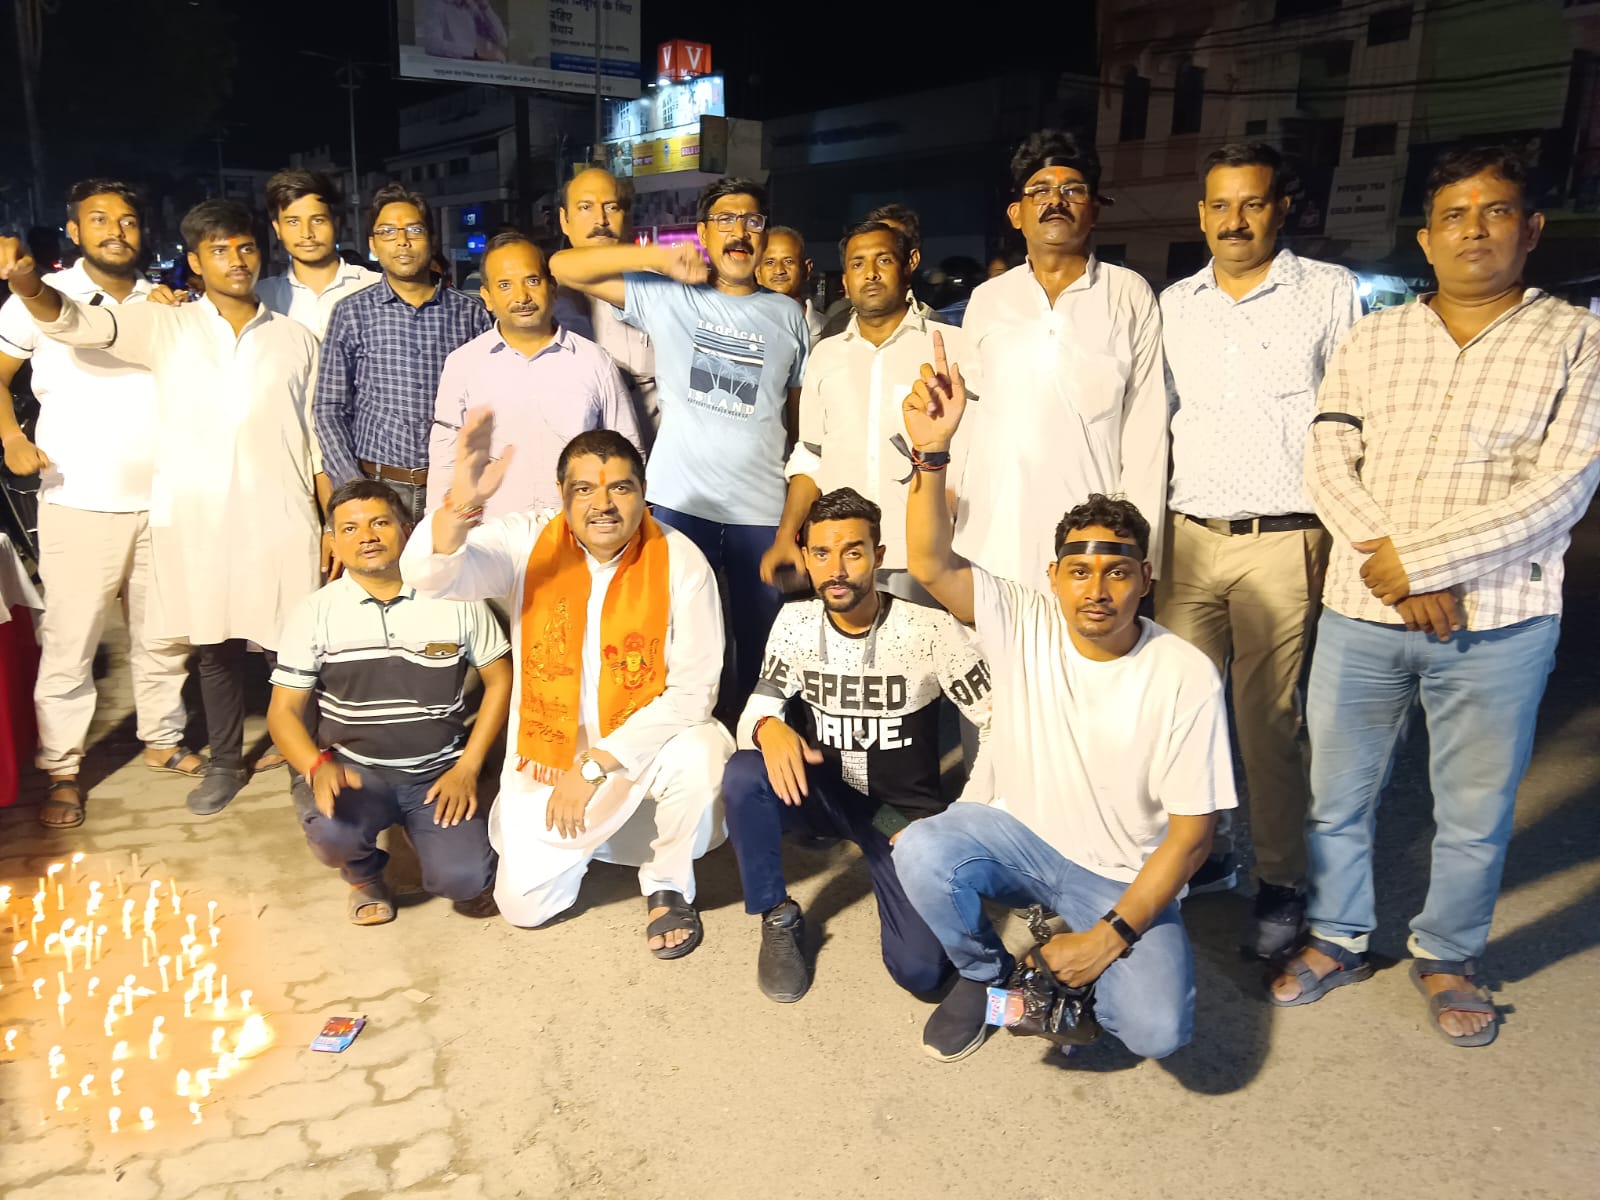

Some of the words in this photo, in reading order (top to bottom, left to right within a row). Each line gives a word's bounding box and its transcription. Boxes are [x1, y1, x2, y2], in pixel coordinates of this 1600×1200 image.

[685, 45, 703, 70] V
[697, 318, 766, 343] TROPICAL
[687, 387, 755, 414] ISLAND
[803, 670, 907, 711] SPEED
